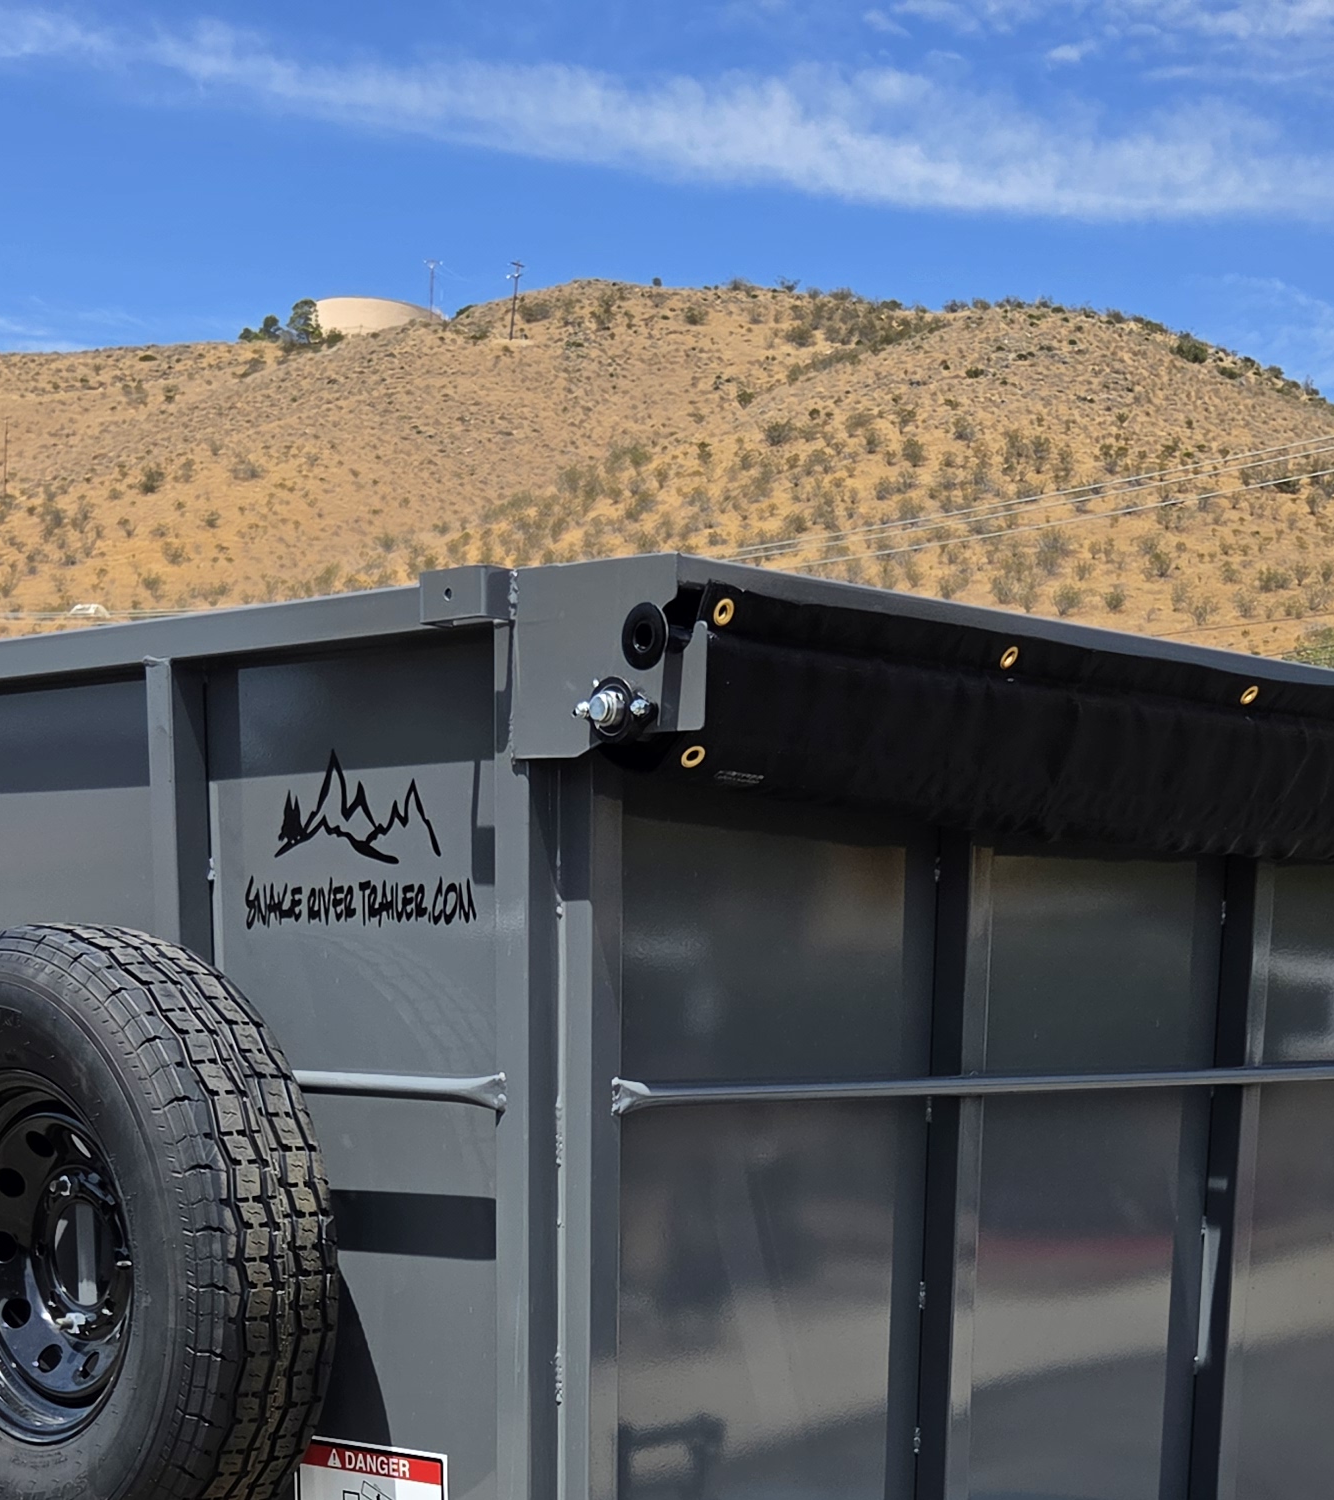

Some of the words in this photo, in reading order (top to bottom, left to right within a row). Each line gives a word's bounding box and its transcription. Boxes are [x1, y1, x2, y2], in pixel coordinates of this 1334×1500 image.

[244, 876, 303, 930] SNAKE
[307, 877, 357, 926] RIVER
[358, 876, 477, 928] TRAILER.COM
[344, 1451, 411, 1478] DANGER
